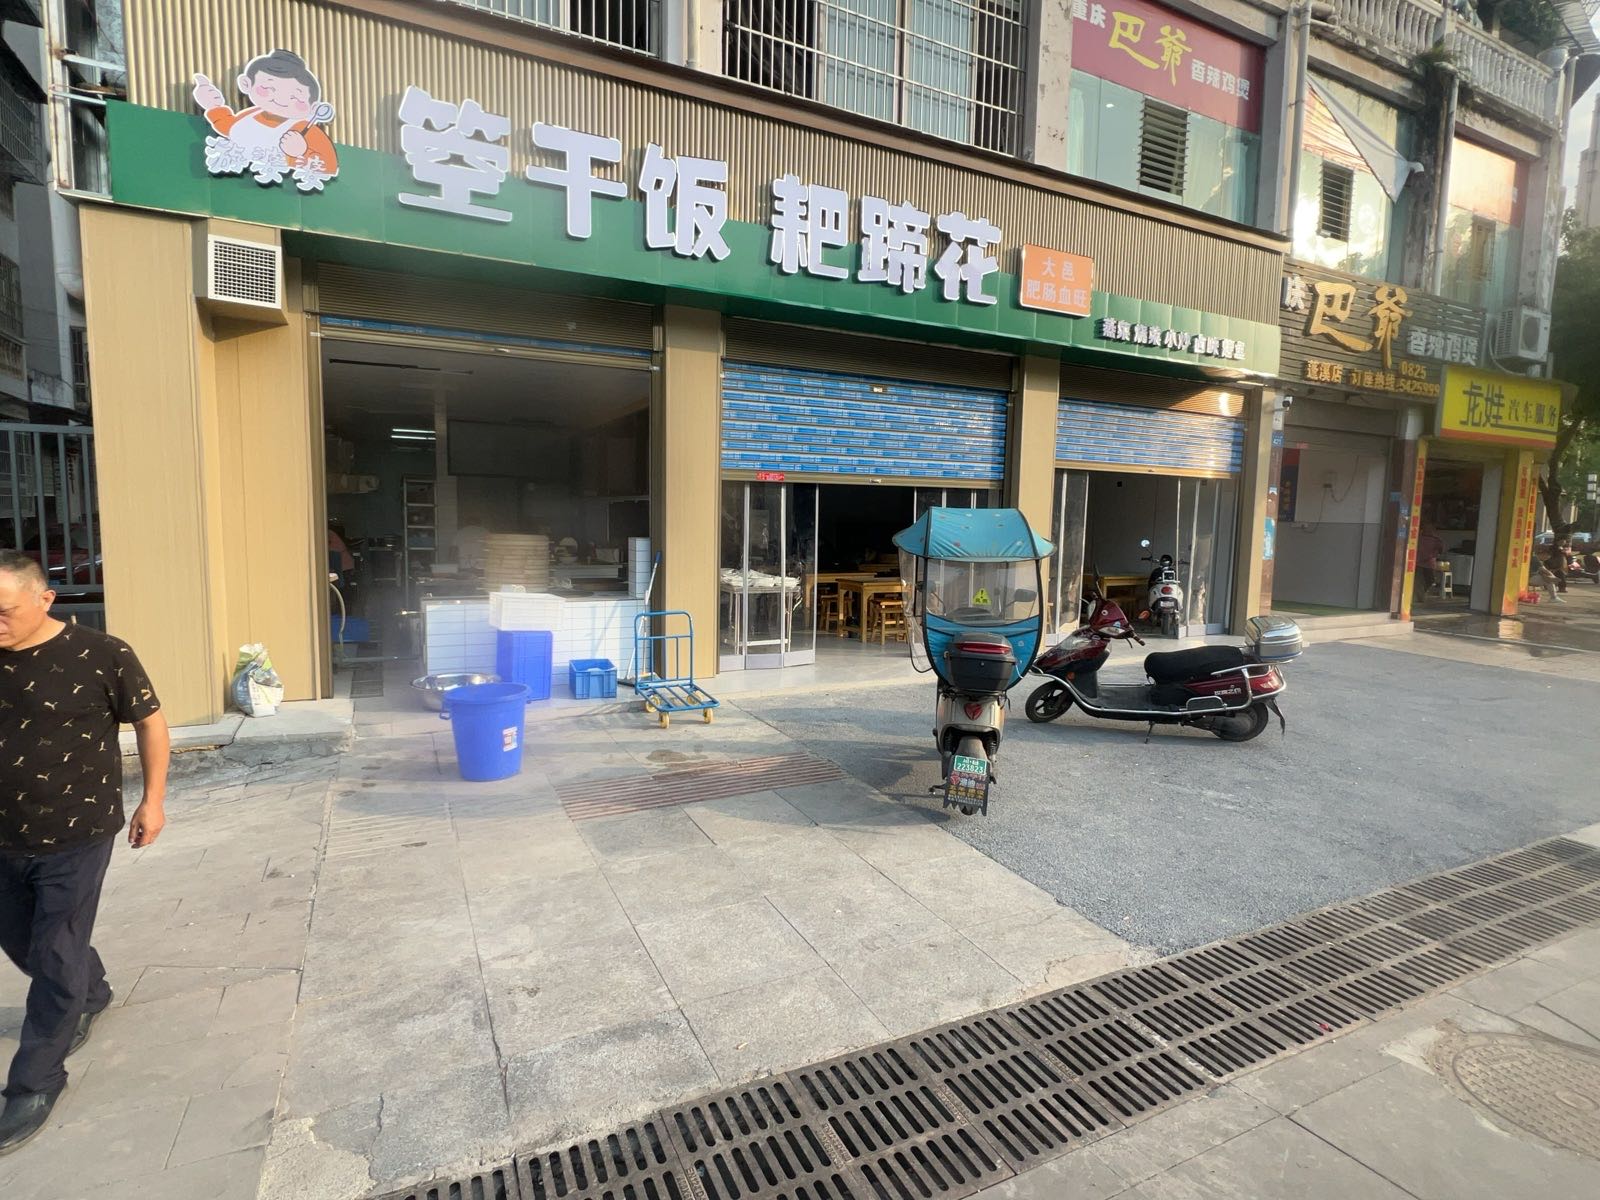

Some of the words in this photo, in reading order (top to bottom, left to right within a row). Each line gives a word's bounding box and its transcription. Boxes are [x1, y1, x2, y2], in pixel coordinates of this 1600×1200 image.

[1041, 256, 1075, 282] 大邑
[1026, 279, 1089, 309] 肥肠血旺
[1400, 361, 1427, 380] 0825
[956, 763, 984, 774] 223823
